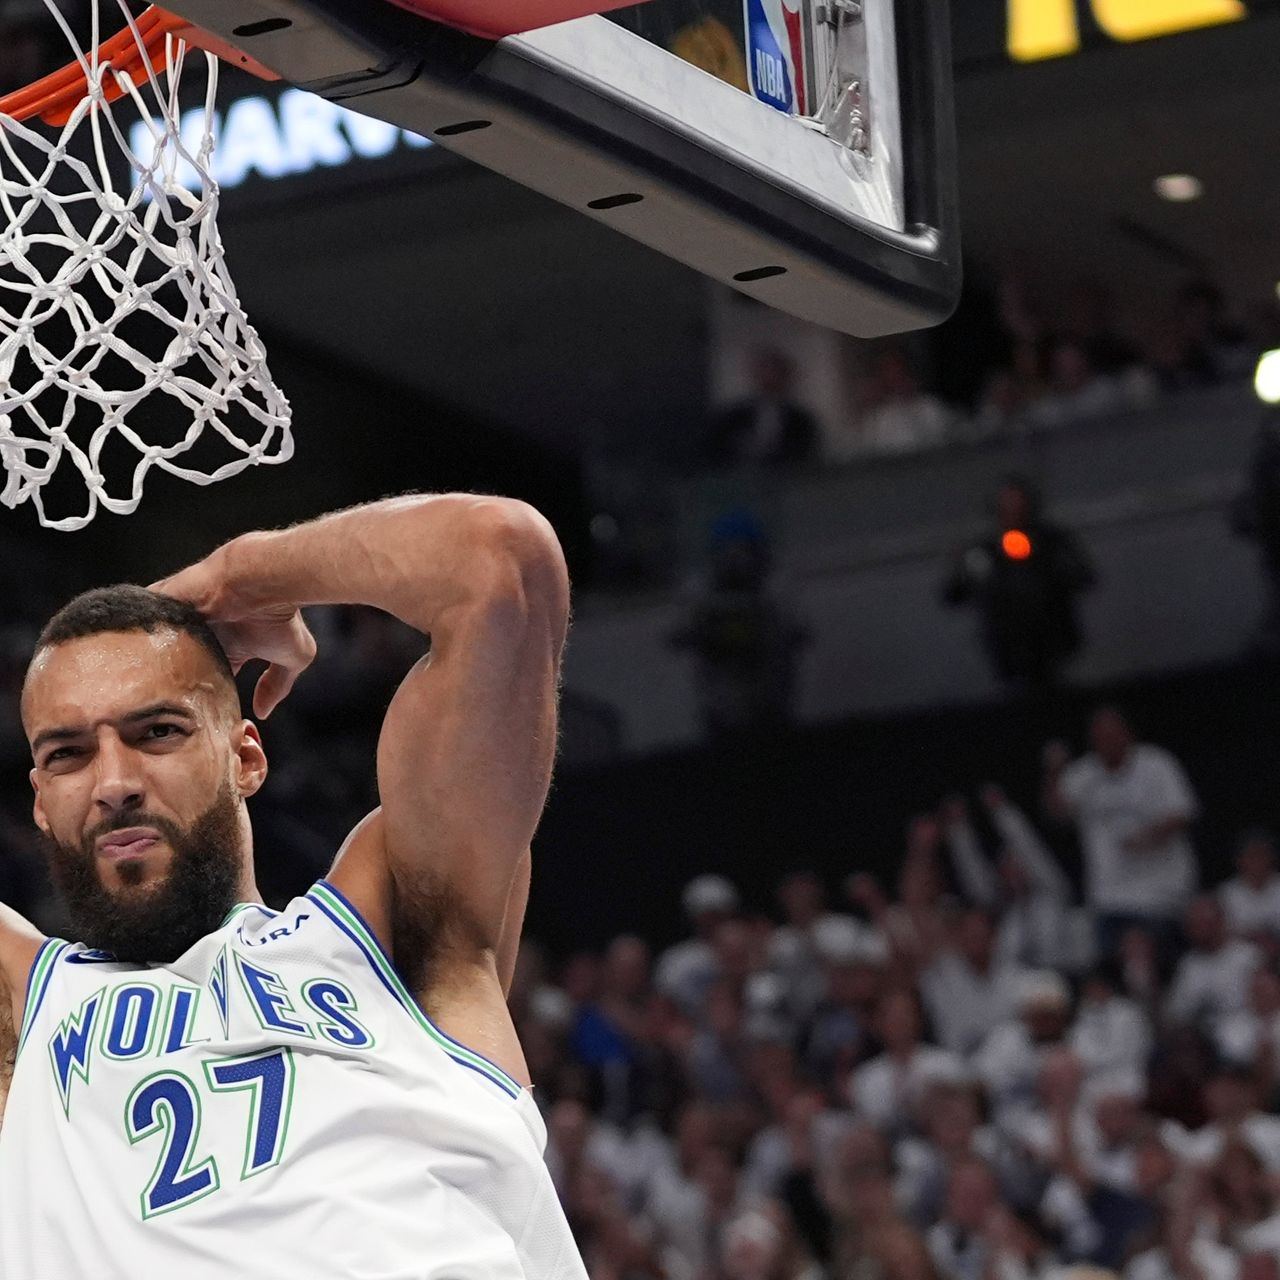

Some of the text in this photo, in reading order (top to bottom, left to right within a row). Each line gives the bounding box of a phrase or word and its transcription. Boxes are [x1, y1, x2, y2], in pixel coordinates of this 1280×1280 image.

[755, 48, 786, 104] NBA
[48, 943, 375, 1122] WOLVES
[124, 1045, 297, 1221] 27
